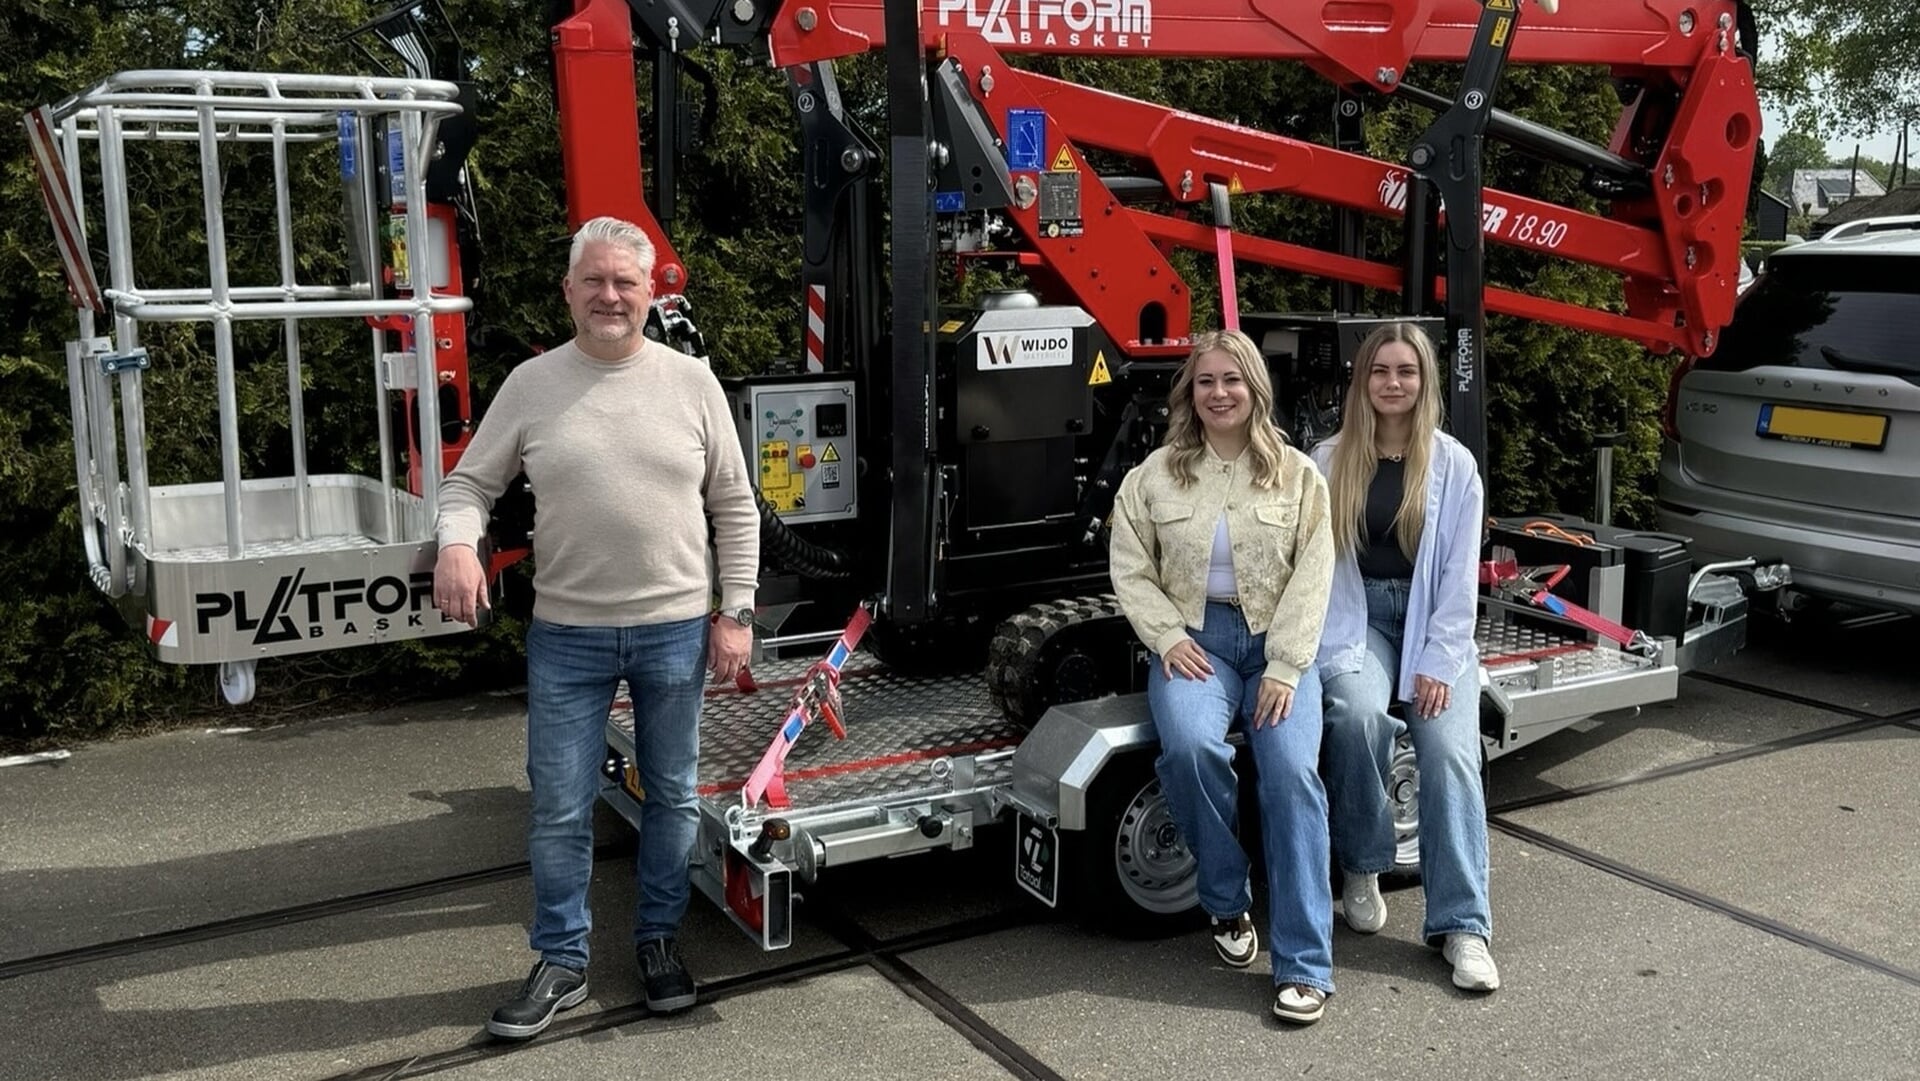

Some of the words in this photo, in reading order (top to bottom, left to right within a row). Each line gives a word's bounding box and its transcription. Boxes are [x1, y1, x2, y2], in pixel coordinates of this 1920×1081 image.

[1020, 32, 1151, 48] BASKET
[1508, 212, 1568, 249] 18.90
[1021, 337, 1068, 352] WIJDO
[1455, 328, 1473, 392] PLATFORM
[1755, 377, 1890, 397] VOLVO
[195, 567, 435, 645] PLATFOR
[309, 612, 454, 639] BASKE
